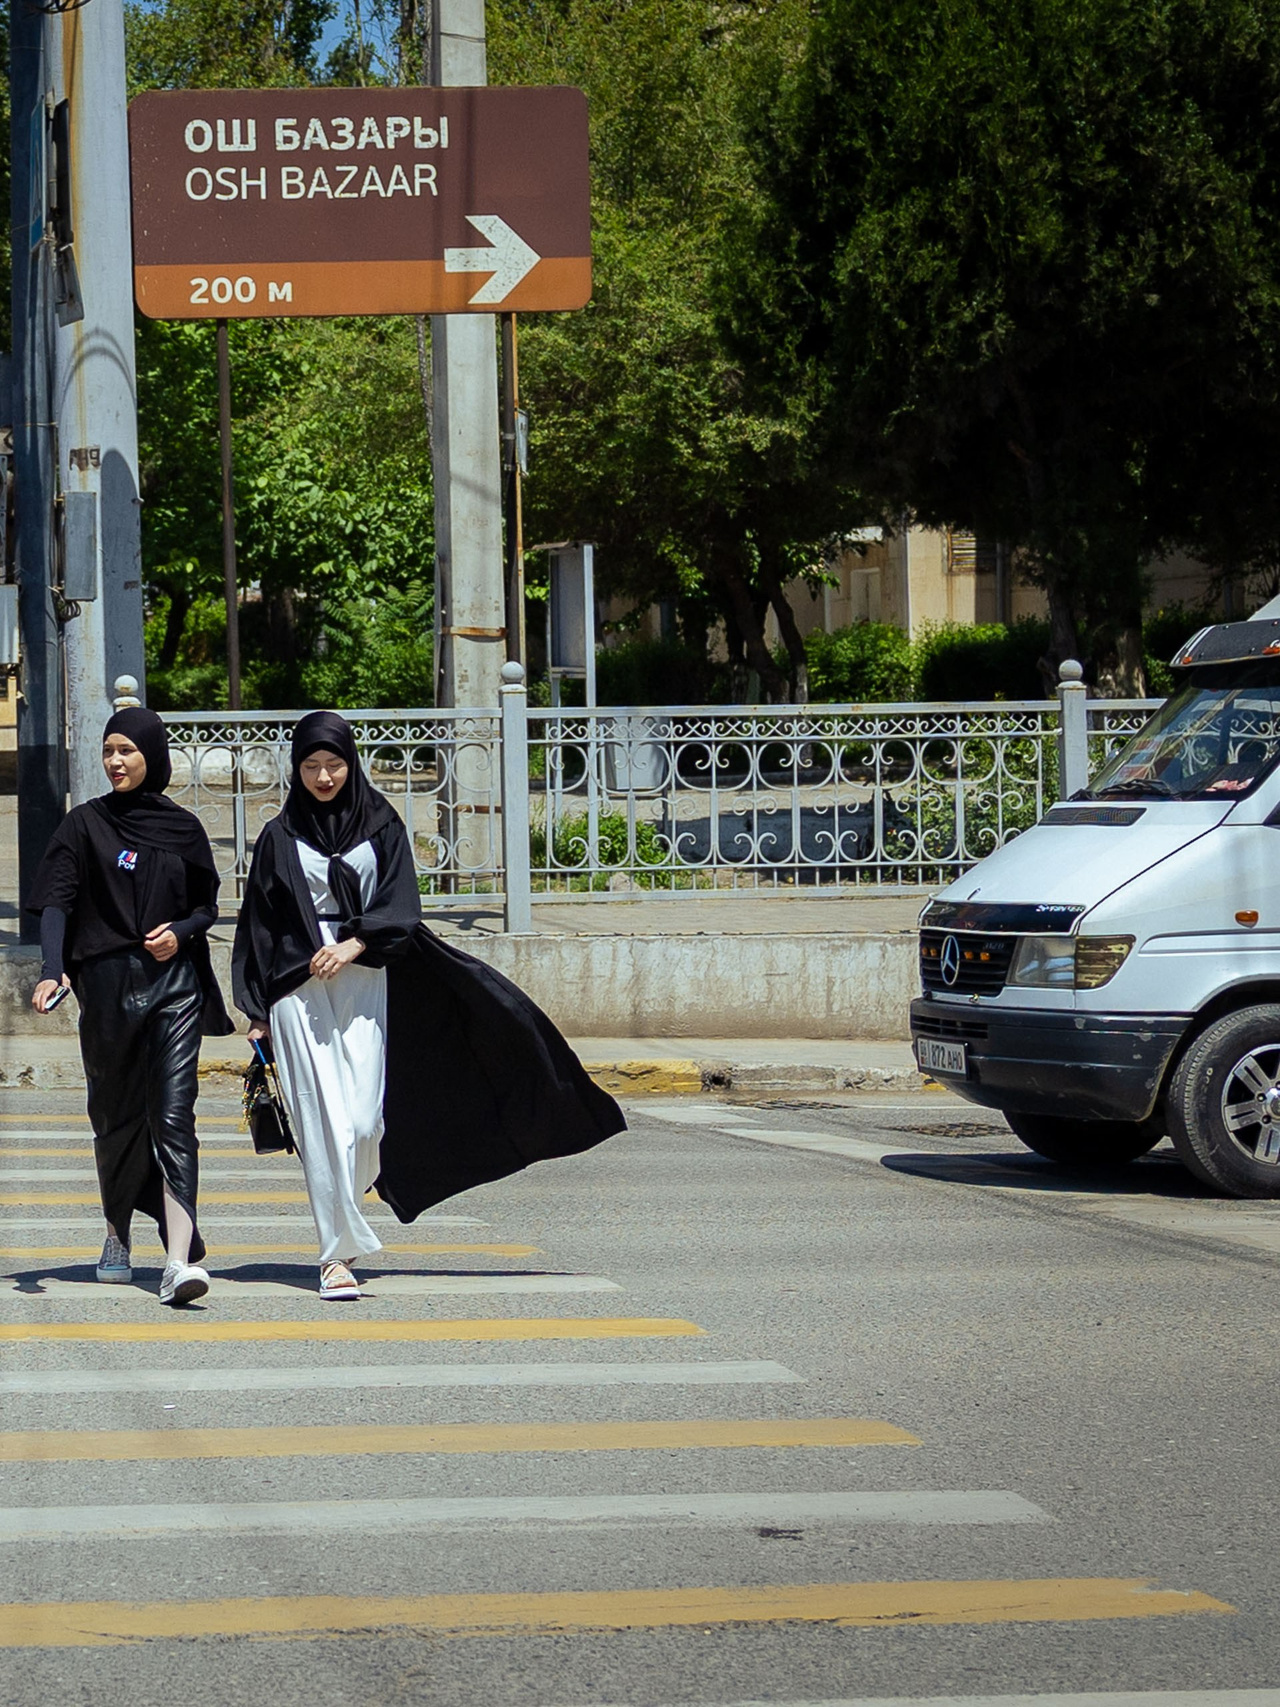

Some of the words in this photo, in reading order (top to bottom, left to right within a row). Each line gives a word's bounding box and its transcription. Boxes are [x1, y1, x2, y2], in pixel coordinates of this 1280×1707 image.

[184, 119, 257, 152] ОШ
[275, 116, 449, 151] БАЗАРЫ
[185, 166, 267, 200] OSH
[281, 163, 438, 199] BAZAAR
[189, 276, 257, 304] 200
